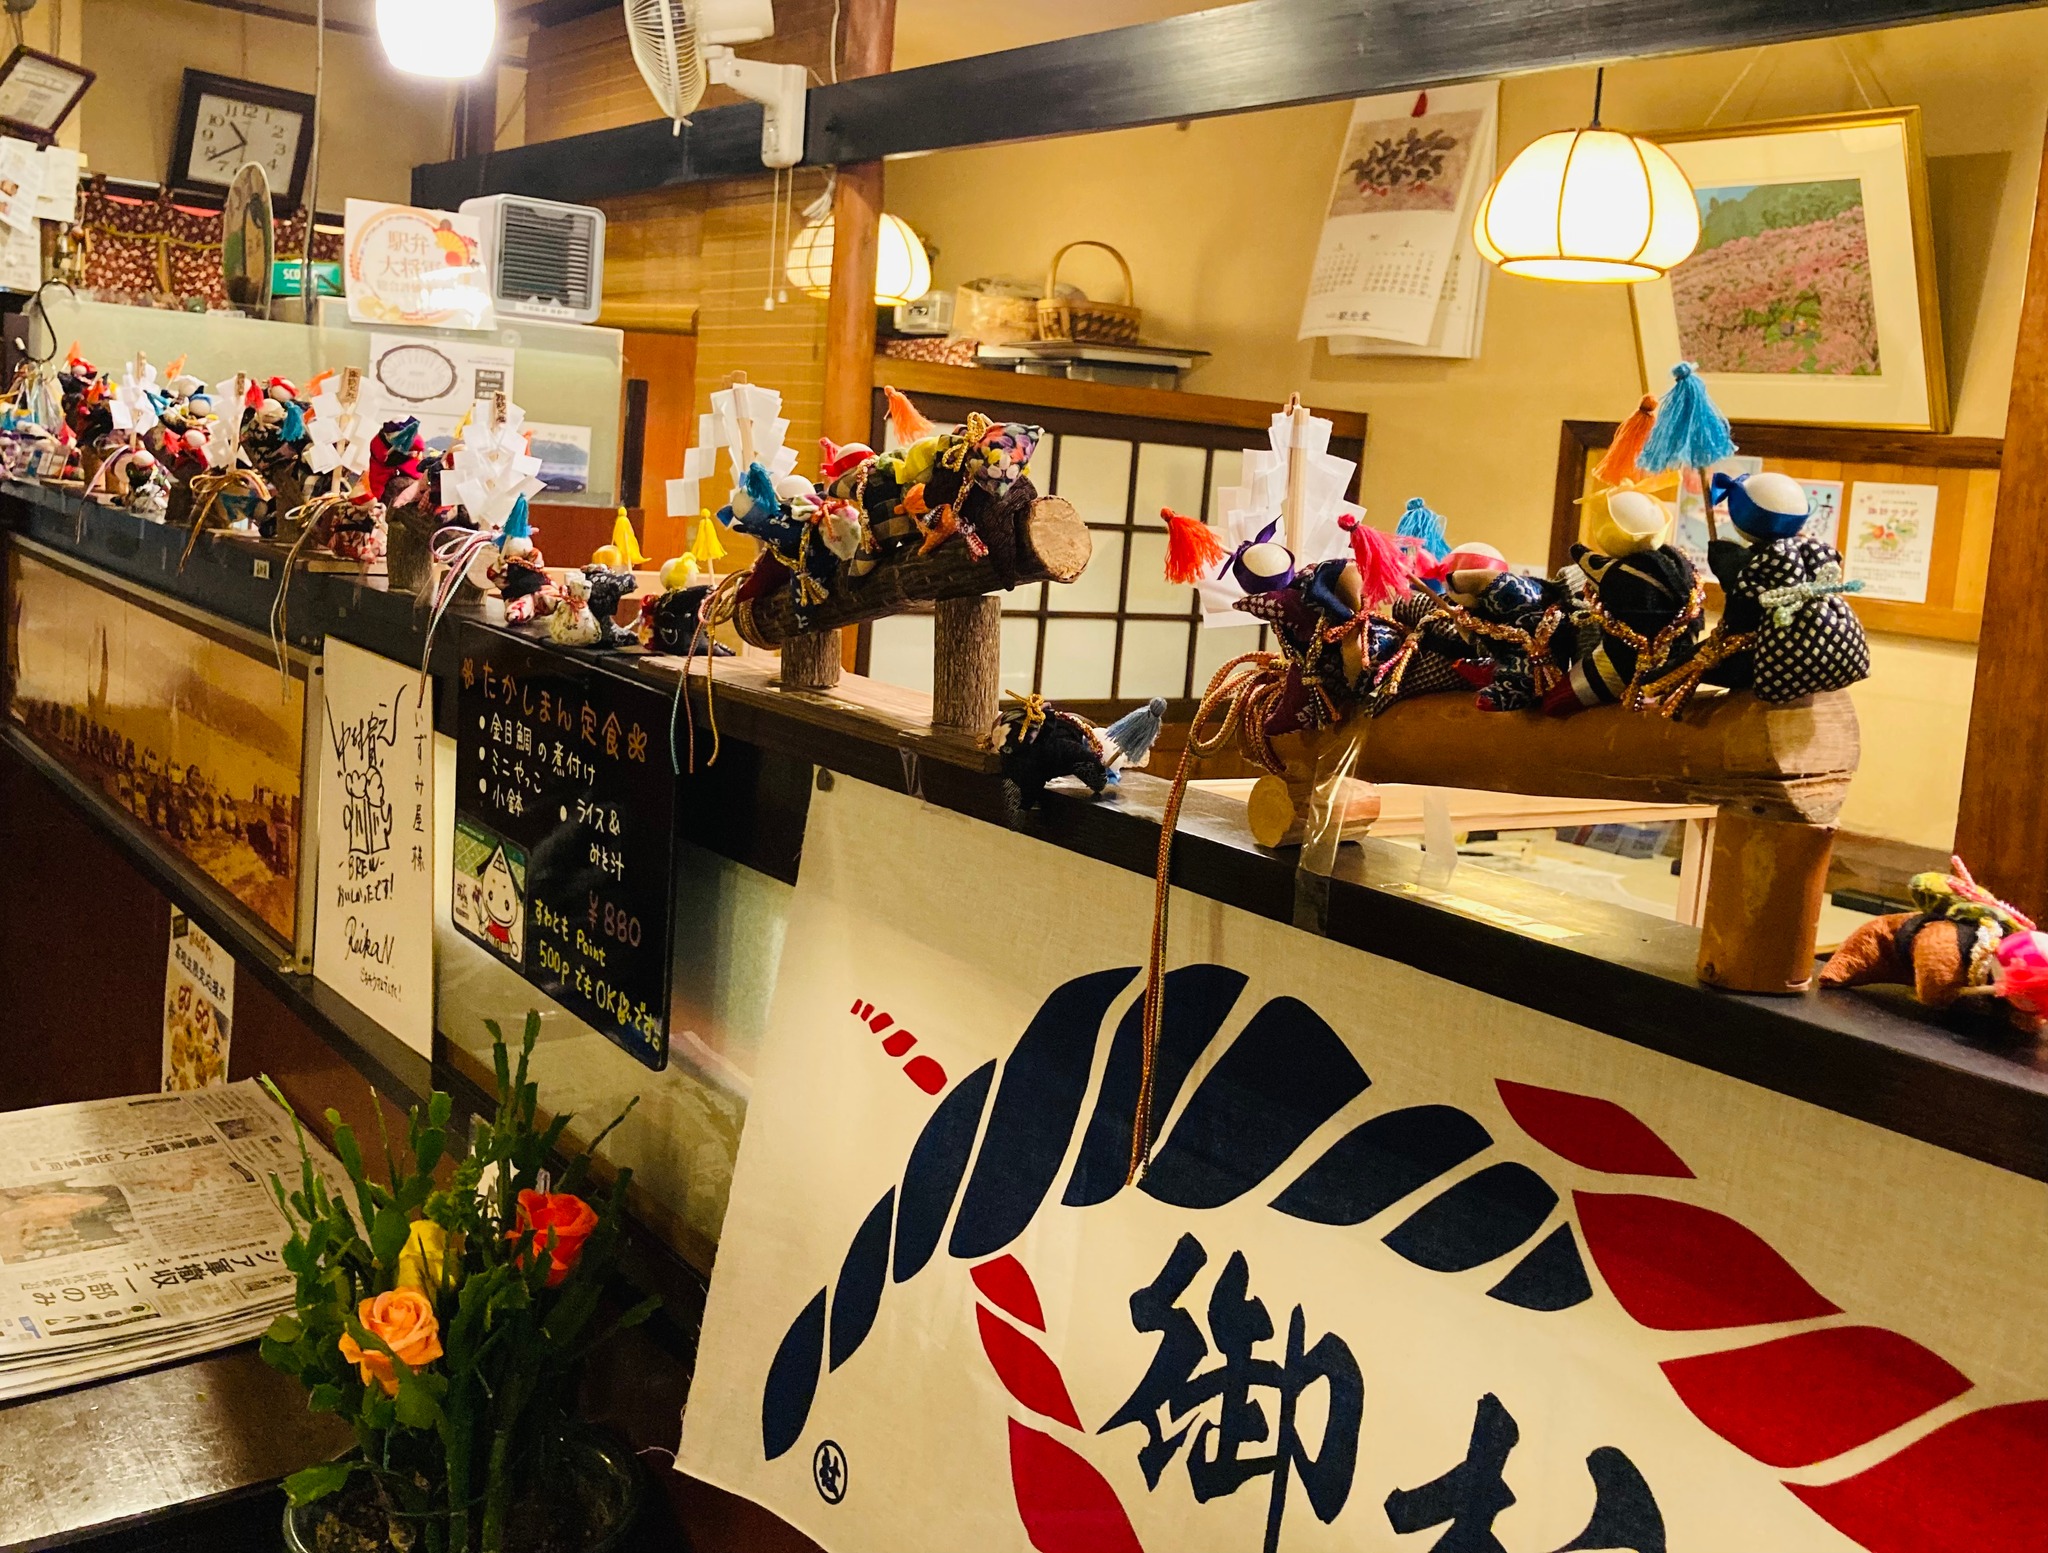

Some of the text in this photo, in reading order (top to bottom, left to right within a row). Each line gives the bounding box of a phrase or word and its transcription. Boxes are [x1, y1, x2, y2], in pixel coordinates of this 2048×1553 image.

[226, 104, 237, 117] 11
[242, 105, 258, 118] 12
[208, 114, 225, 127] 10
[264, 112, 270, 124] 1
[202, 129, 214, 141] 9
[272, 126, 284, 138] 2
[275, 143, 286, 156] 3
[217, 161, 229, 171] 7
[267, 159, 277, 171] 4
[388, 231, 430, 255] 駅弁
[490, 712, 596, 786] 金目鯛の煮付け
[492, 748, 542, 793] ミニやっこ
[493, 784, 523, 817] 小鉢
[589, 843, 625, 881] みそ汁
[588, 890, 641, 947] ¥880
[576, 930, 606, 967] Point
[150, 1250, 279, 1290] シア軍撤収
